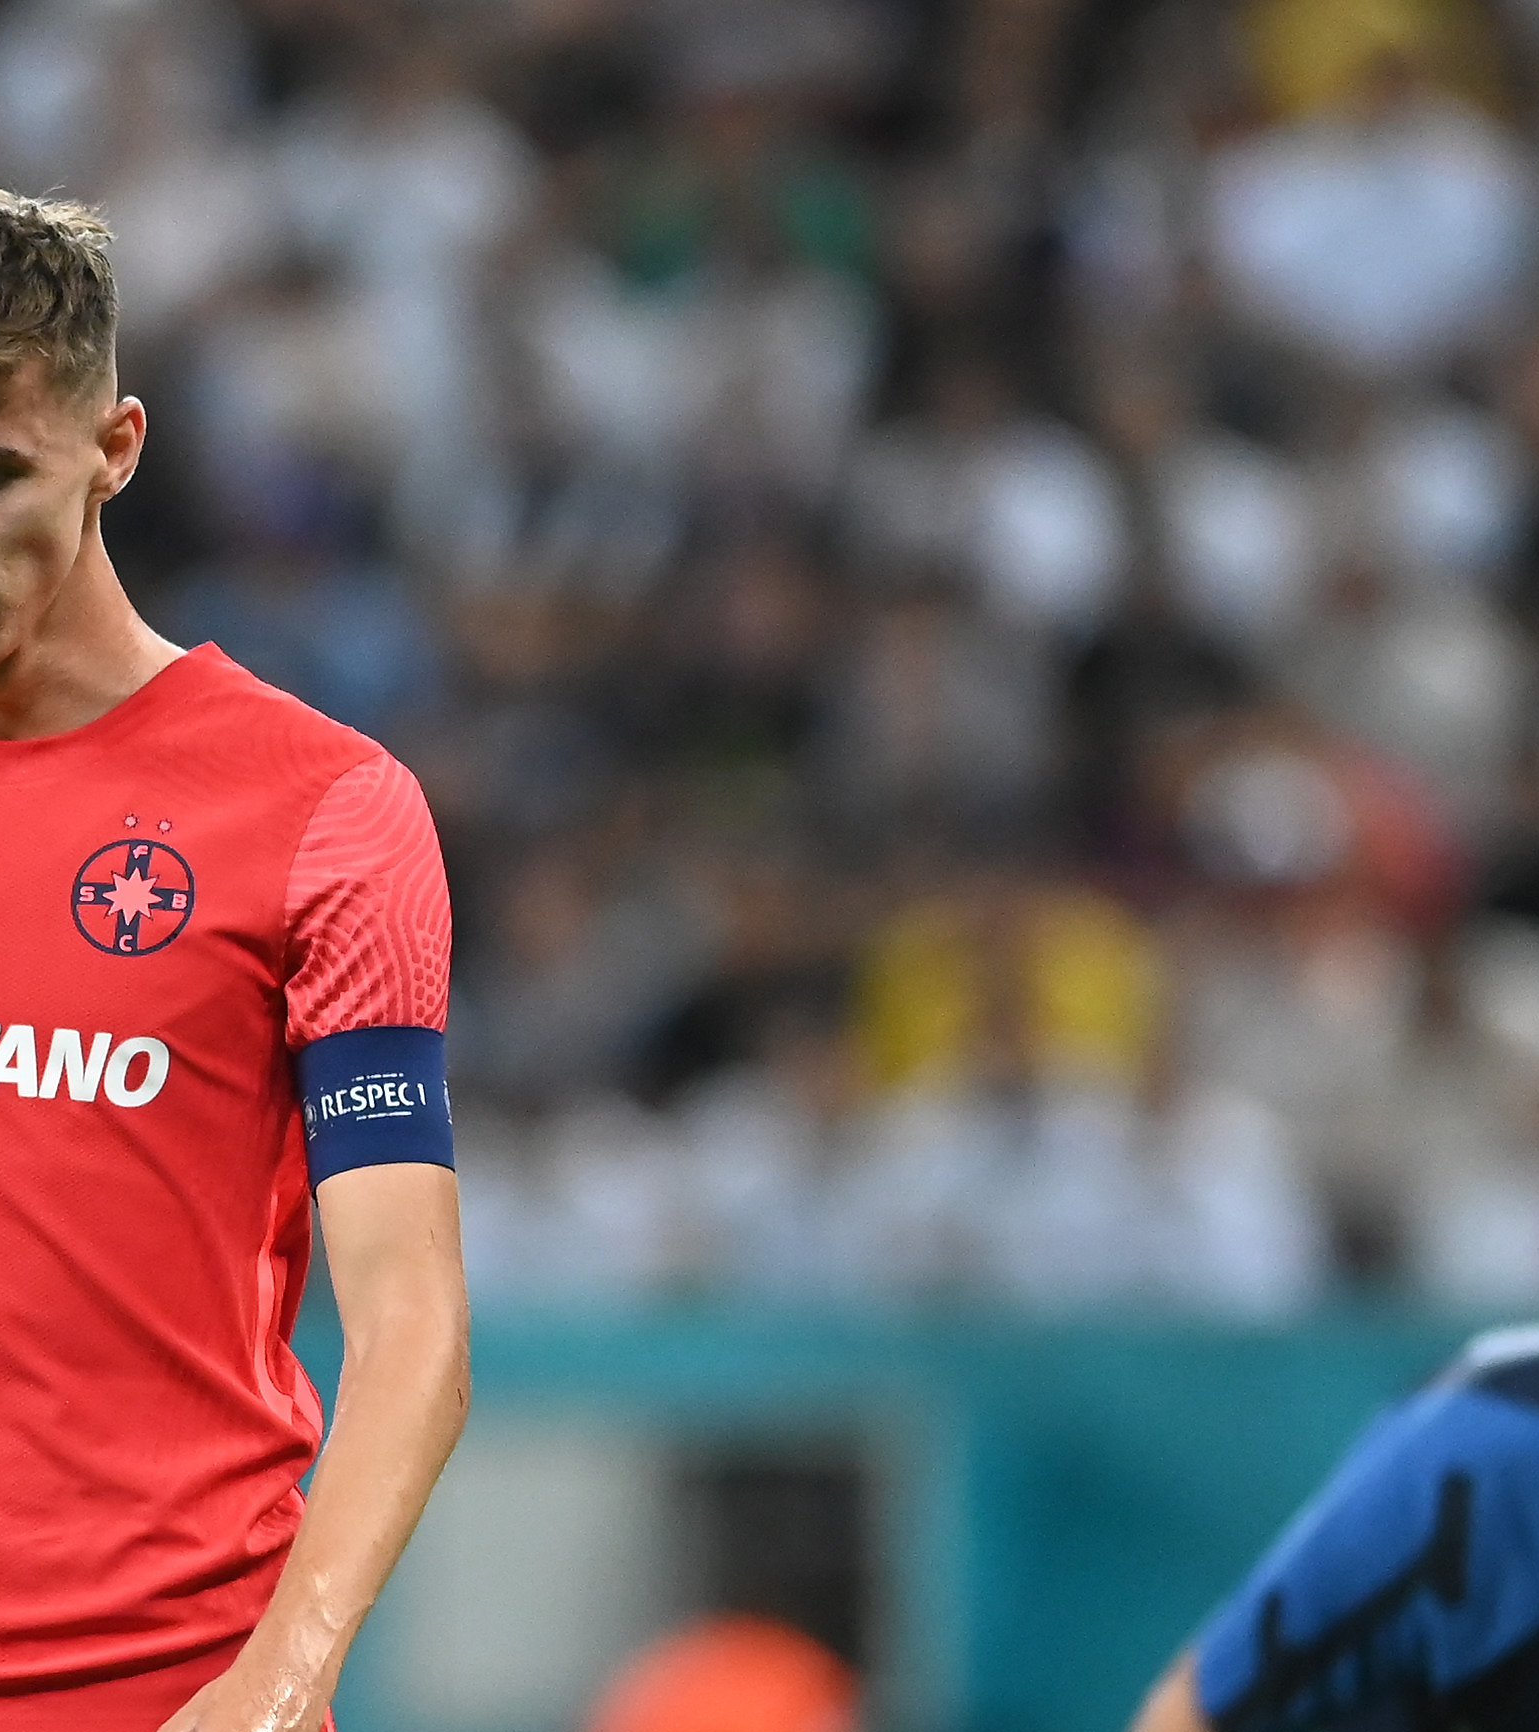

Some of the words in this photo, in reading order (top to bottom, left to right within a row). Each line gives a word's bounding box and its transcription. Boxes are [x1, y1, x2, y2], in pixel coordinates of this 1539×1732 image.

[79, 885, 95, 902] S
[171, 893, 188, 909] B
[119, 934, 133, 952] C
